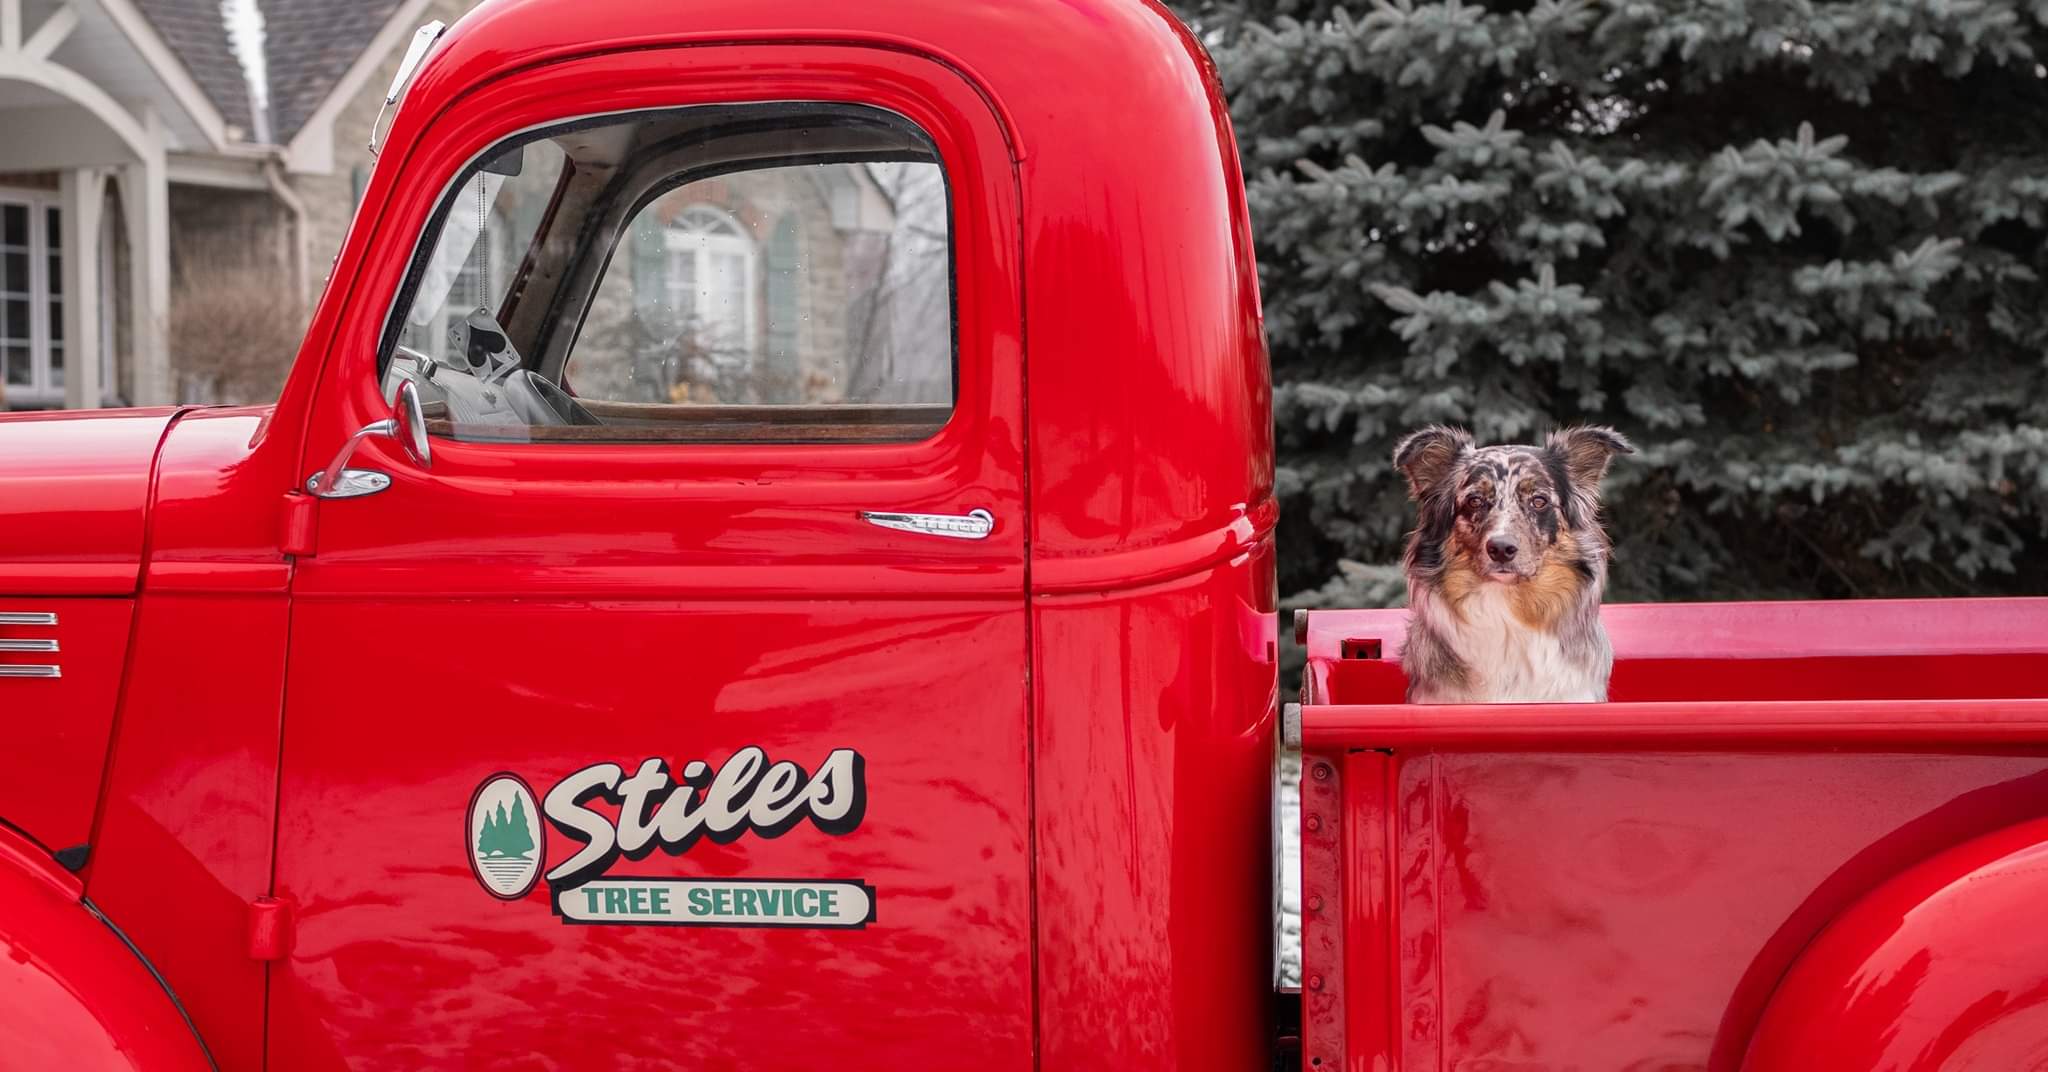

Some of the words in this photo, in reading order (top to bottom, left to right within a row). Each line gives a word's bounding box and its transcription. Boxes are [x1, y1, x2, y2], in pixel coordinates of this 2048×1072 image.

[543, 745, 856, 882] Stiles
[581, 887, 671, 915] TREE
[688, 888, 840, 918] SERVICE
